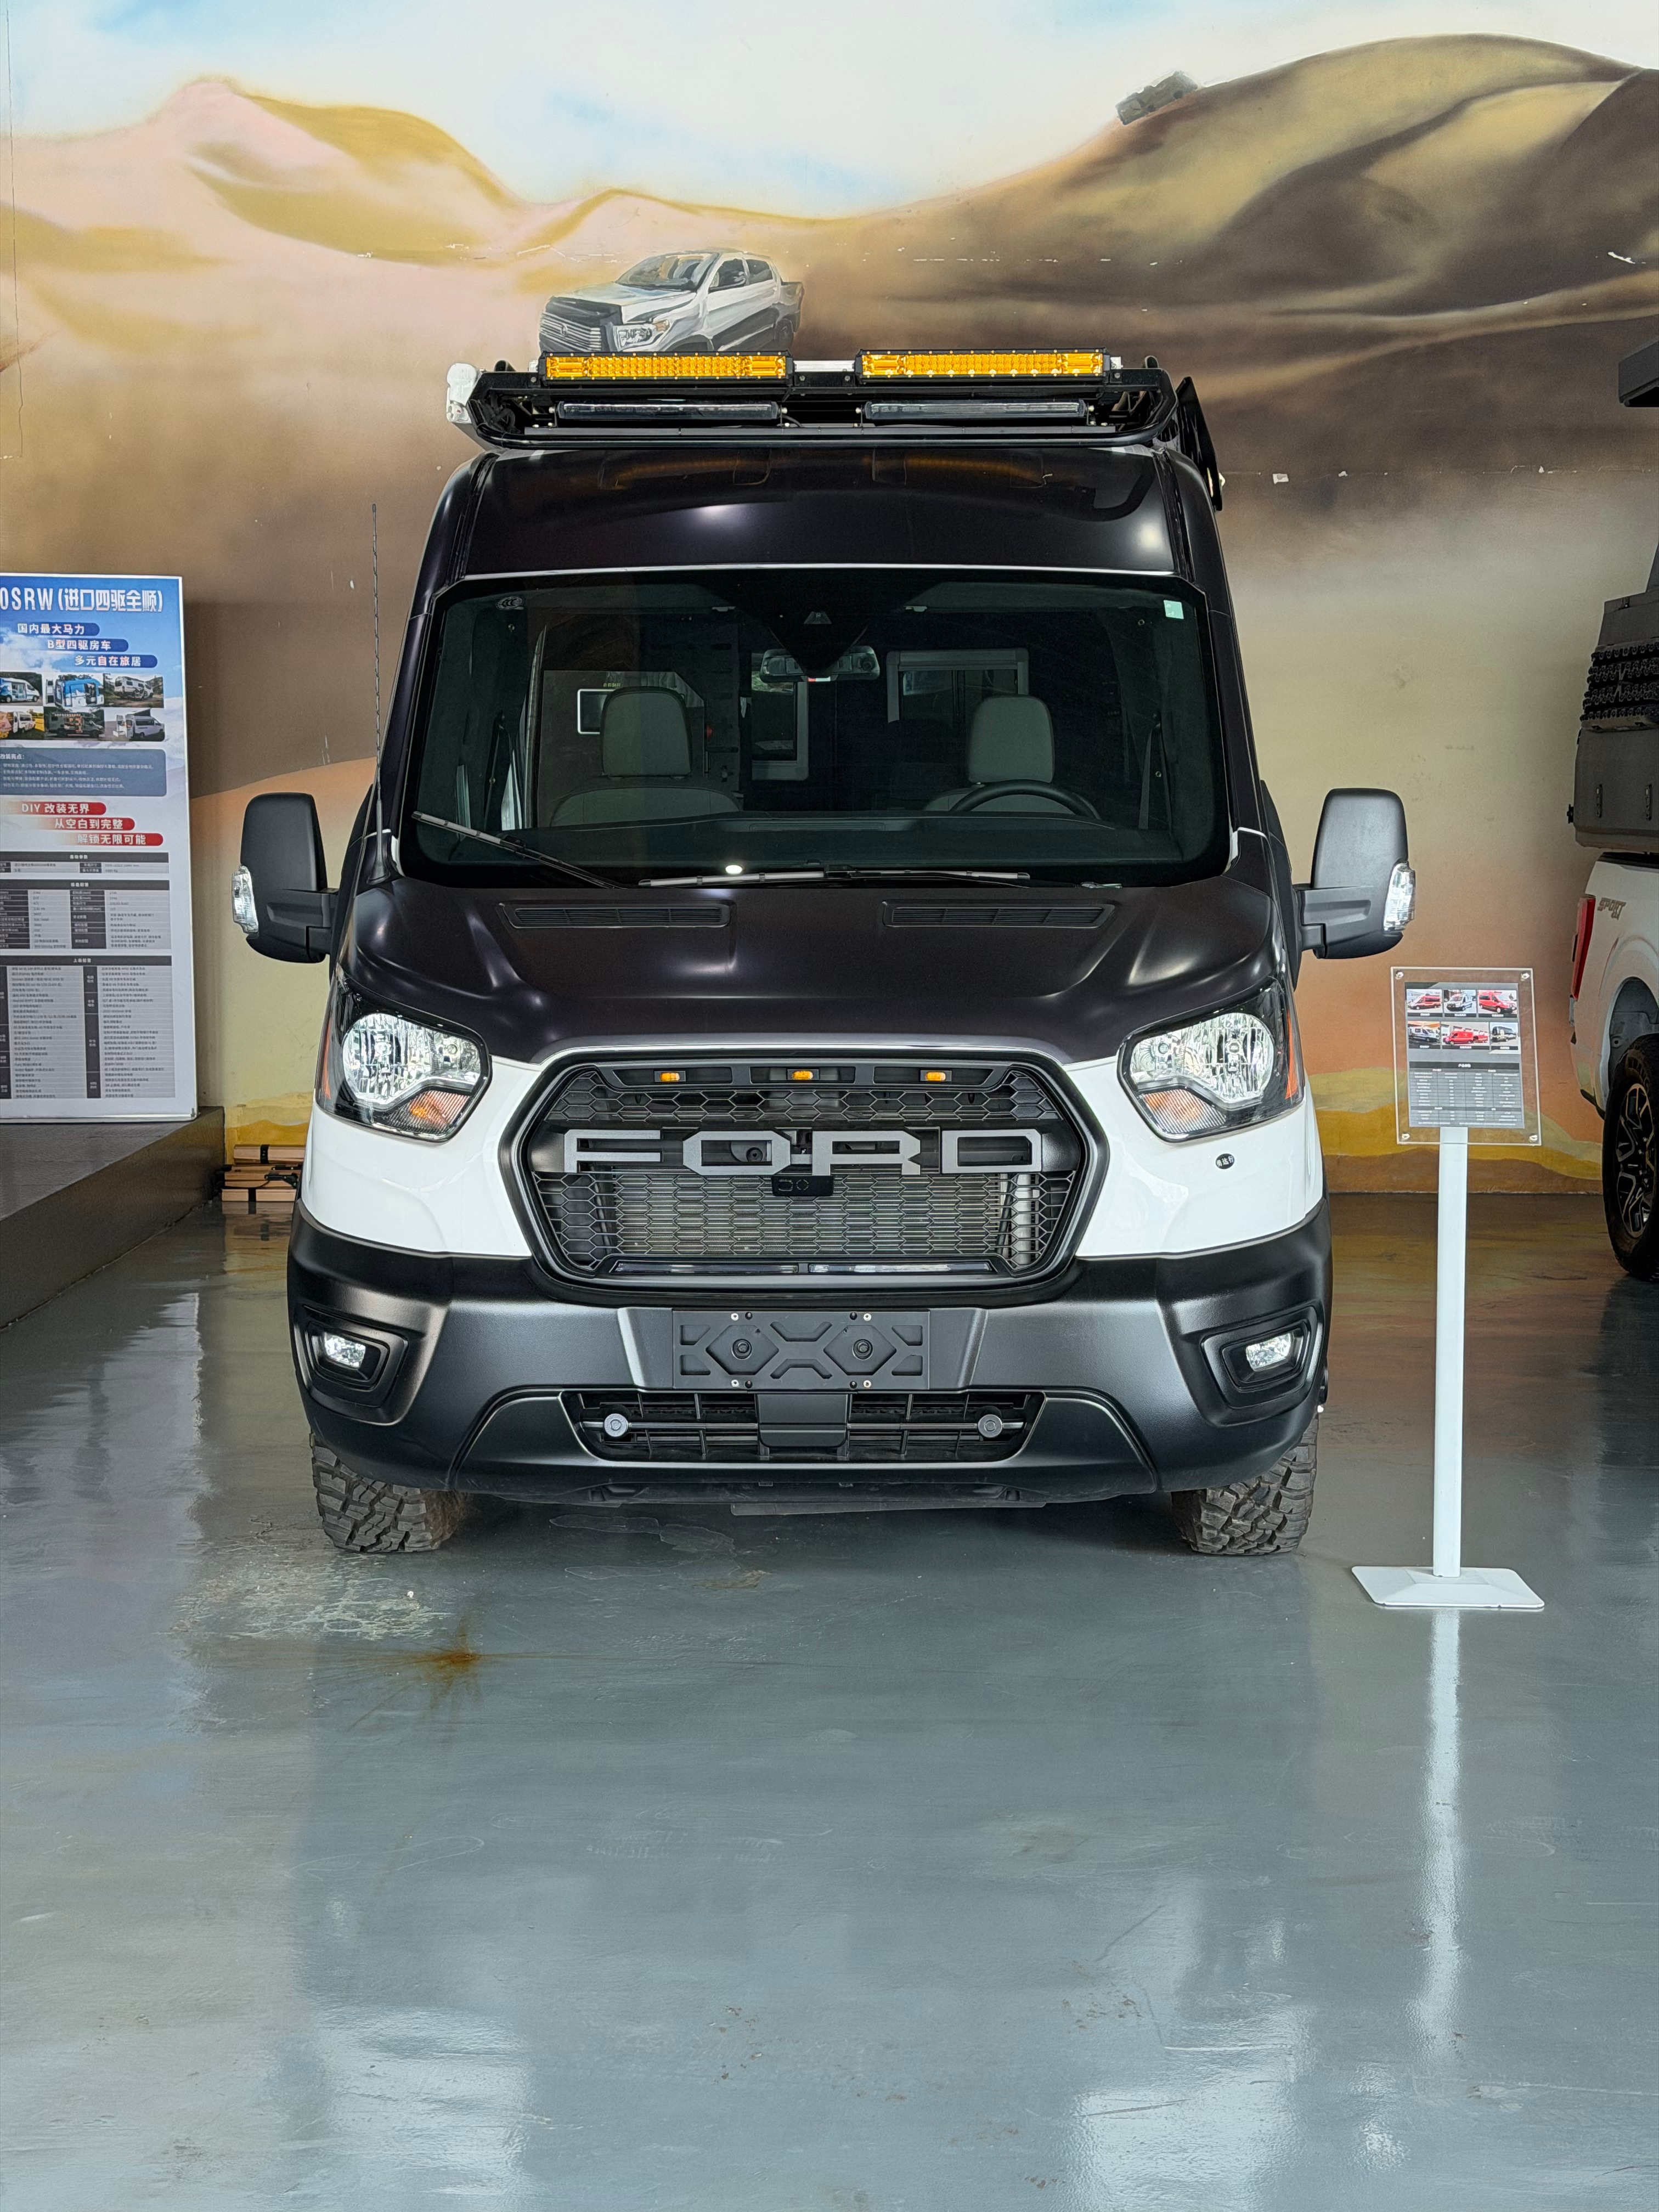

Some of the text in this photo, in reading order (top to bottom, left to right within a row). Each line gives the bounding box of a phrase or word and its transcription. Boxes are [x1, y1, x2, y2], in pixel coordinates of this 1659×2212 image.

[17, 623, 84, 635] 国内最大马力
[47, 640, 111, 651] B型四驱房车
[75, 655, 142, 667] 多元自在旅居
[22, 803, 89, 814] DIY 改装无界
[55, 819, 123, 830] 从空白到完整
[77, 834, 146, 845] 解锁无限可能
[564, 1128, 1042, 1176] FORD
